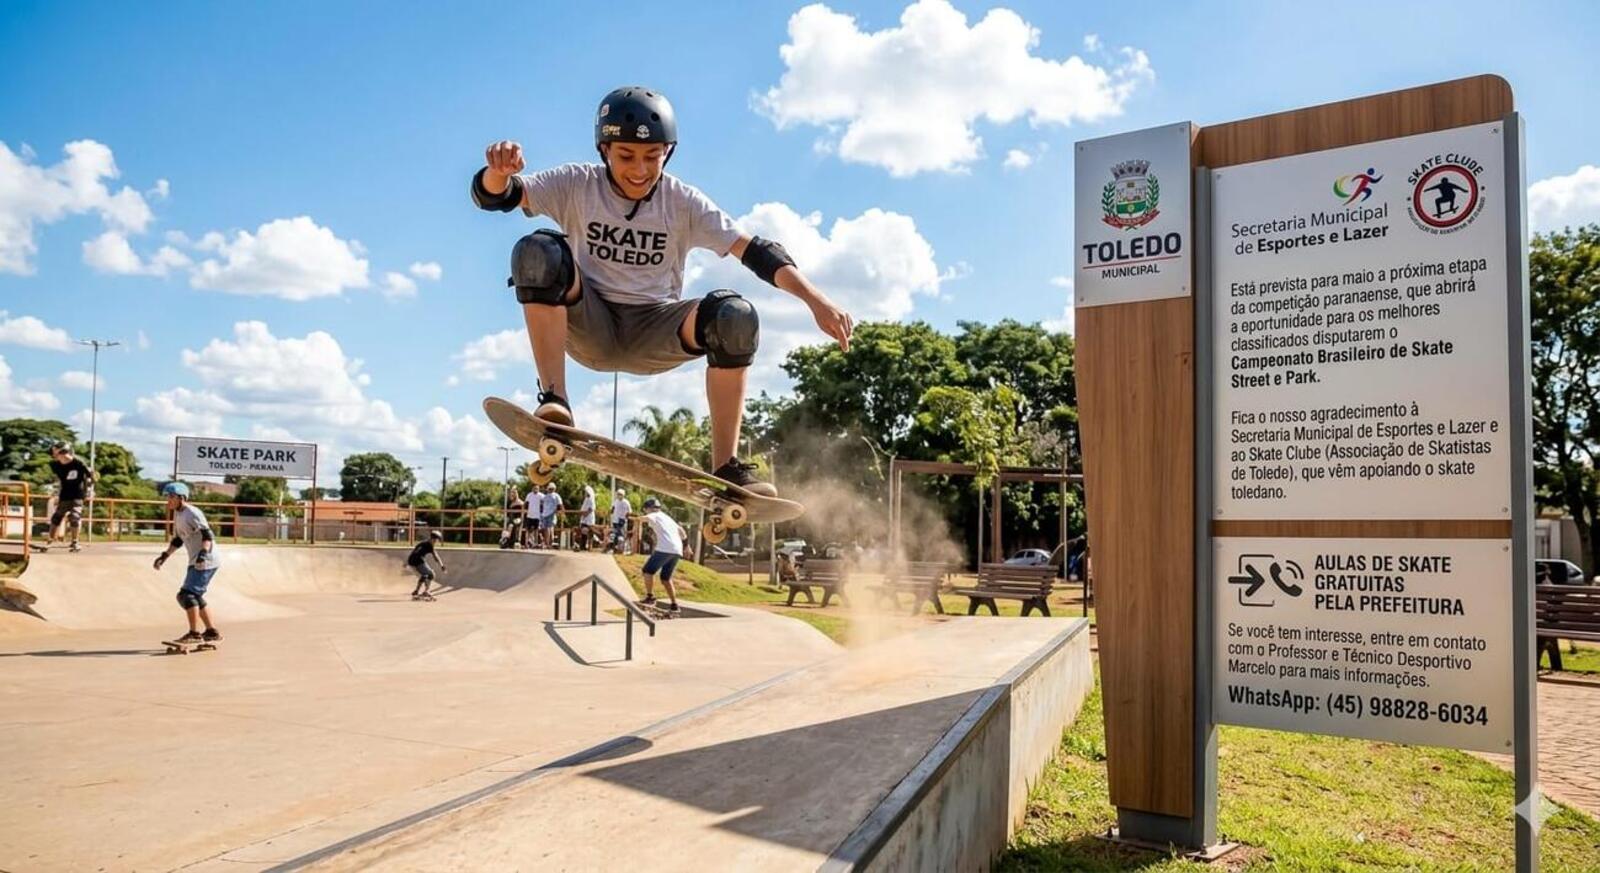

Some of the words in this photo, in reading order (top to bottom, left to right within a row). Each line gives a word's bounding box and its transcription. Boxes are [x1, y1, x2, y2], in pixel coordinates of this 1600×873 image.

[1408, 155, 1442, 185] SKATE
[1231, 215, 1306, 239] Secretaria
[1310, 203, 1388, 228] Municipal
[587, 222, 667, 250] SKATE
[1083, 232, 1181, 264] TOLEDO
[1235, 239, 1253, 256] de
[1258, 231, 1324, 254] Esportes
[1329, 232, 1339, 244] e
[1343, 224, 1388, 242] Lazer
[587, 242, 664, 266] TOLEDO
[1102, 264, 1160, 278] MUNICIPAL
[1260, 276, 1307, 296] prevista
[1311, 274, 1338, 292] para
[1343, 270, 1374, 285] maio
[1378, 270, 1385, 281] a
[1390, 263, 1444, 280] próxima
[1449, 258, 1487, 274] etapa
[1231, 301, 1245, 315] da
[1407, 283, 1431, 299] que
[1436, 276, 1475, 295] abrirá
[1231, 323, 1237, 333] a
[1327, 310, 1354, 327] para
[1359, 310, 1373, 321] os
[1378, 303, 1440, 320] melhores
[1231, 331, 1309, 351] classificados
[1313, 326, 1385, 347] disputarem
[1390, 328, 1397, 338] o
[1232, 349, 1313, 370] Campeonato
[1318, 344, 1385, 364] Brasileiro
[1390, 344, 1407, 357] de
[1412, 339, 1453, 356] Skate
[1232, 372, 1269, 388] Street
[1274, 372, 1281, 385] e
[1286, 369, 1320, 384] Park.
[1232, 411, 1255, 424] Fica
[1259, 412, 1266, 423] o
[1270, 410, 1306, 423] nosso
[1311, 403, 1406, 423] agradecimento
[1232, 426, 1290, 443] Secretaria
[1294, 420, 1353, 441] Municipal
[1357, 422, 1372, 438] de
[1377, 420, 1433, 440] Esportes
[1437, 422, 1445, 435] e
[1450, 420, 1486, 434] Lazer
[1490, 420, 1498, 432] e
[197, 446, 249, 460] SKATE
[254, 449, 296, 462] PARK
[1232, 451, 1245, 461] ao
[1249, 447, 1282, 461] Skate
[1286, 444, 1321, 459] Clube
[1408, 441, 1424, 455] de
[1429, 440, 1491, 455] Skatistas
[1232, 467, 1246, 481] de
[1302, 465, 1324, 482] que
[1359, 461, 1420, 480] apoiando
[1425, 463, 1433, 475] o
[1438, 460, 1474, 475] skate
[1232, 484, 1286, 499] toledano.
[1315, 555, 1366, 571] AULAS
[1372, 555, 1393, 571] DE
[1398, 555, 1451, 574] SKATE
[1315, 574, 1404, 592] GRATUITAS
[1315, 594, 1355, 611] PELA
[1360, 595, 1464, 615] PREFEITURA
[1228, 623, 1243, 637] Se
[1278, 626, 1300, 640] tem
[1305, 627, 1366, 645] interesse,
[1371, 631, 1403, 646] entre
[1409, 635, 1429, 647] em
[1434, 635, 1486, 651] contato
[1228, 644, 1253, 655] com
[1257, 646, 1264, 656] o
[1269, 643, 1327, 661] Professor
[1332, 649, 1338, 661] e
[1343, 648, 1392, 666] Técnico
[1398, 652, 1471, 671] Desportivo
[1228, 660, 1275, 675] Marcelo
[1280, 665, 1306, 679] para
[1310, 666, 1340, 681] mais
[1228, 686, 1319, 713] WhatsApp:
[1327, 693, 1363, 718] (45)
[1370, 697, 1487, 726] 98828-6034
